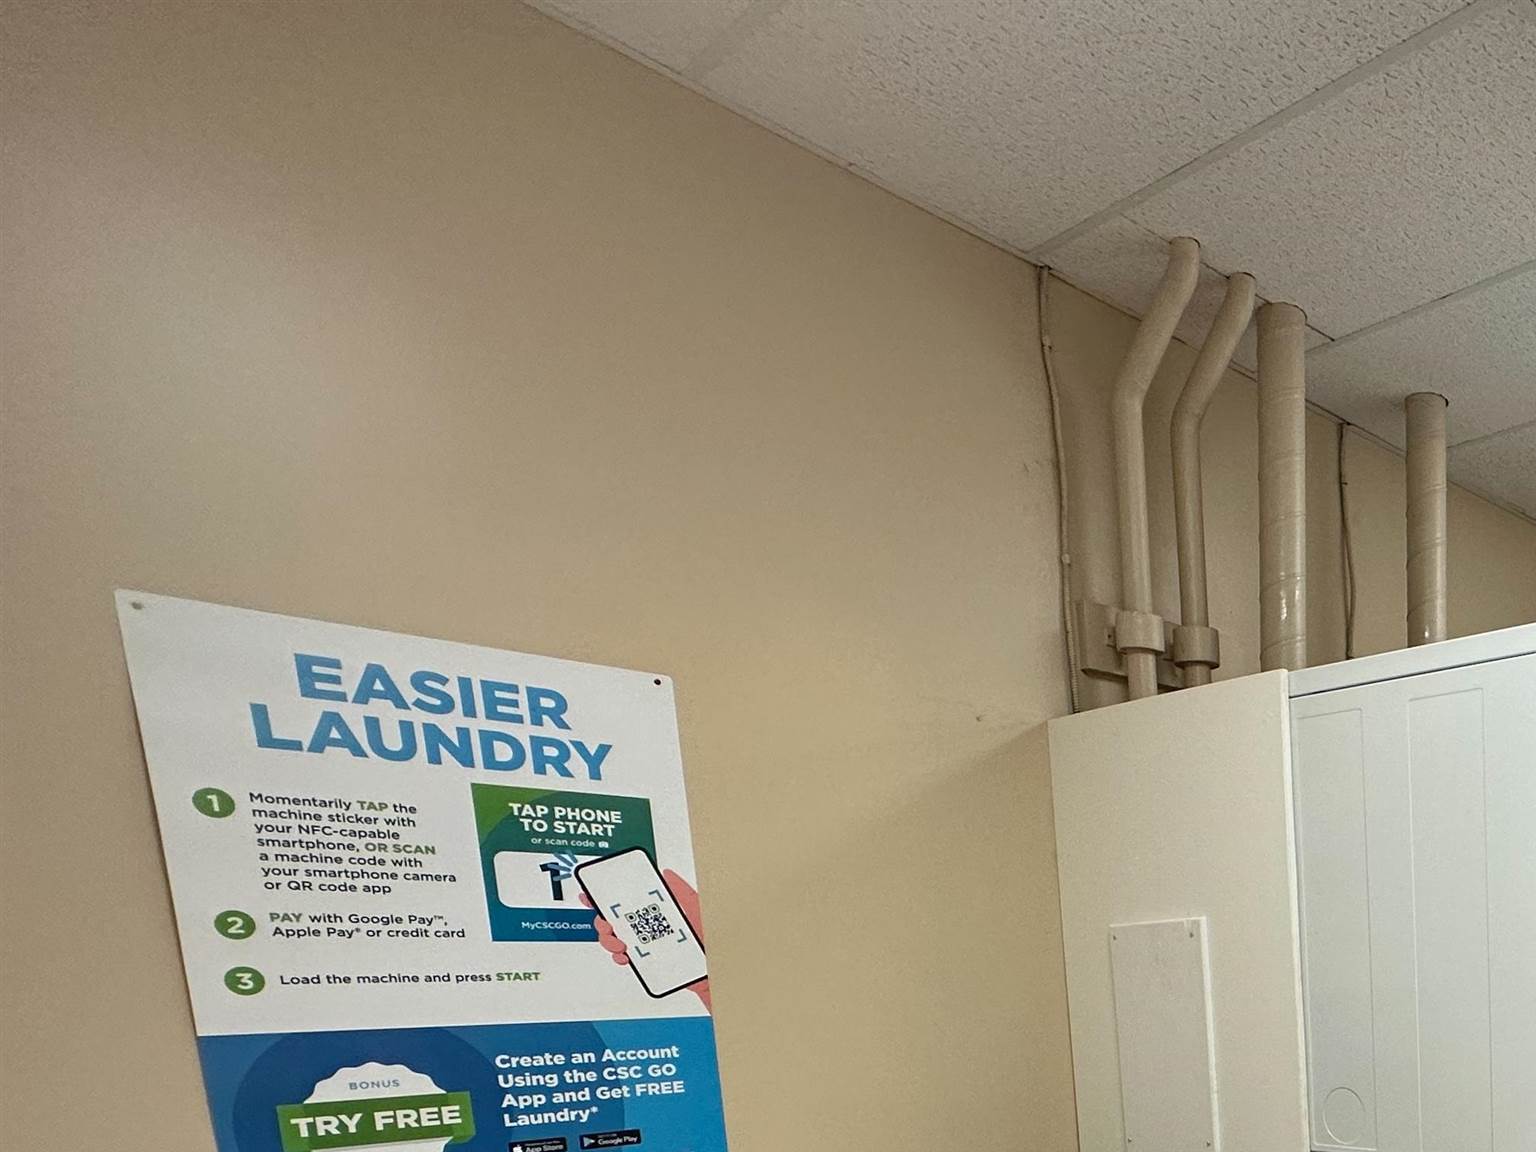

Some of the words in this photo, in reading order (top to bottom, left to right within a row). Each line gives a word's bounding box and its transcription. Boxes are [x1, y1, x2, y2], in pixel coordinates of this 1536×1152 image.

[294, 652, 573, 731] EASIER
[249, 702, 613, 781] LAUNDRY
[207, 794, 220, 812] 1
[249, 792, 351, 811] Momentarily
[357, 800, 388, 811] TAP
[393, 801, 417, 814] the
[252, 808, 322, 822] machine
[327, 812, 379, 825] sticker
[384, 815, 416, 827] with
[508, 802, 549, 818] TAP
[553, 806, 623, 824] PHONE
[254, 823, 292, 834] your
[298, 824, 400, 841] NFC-capable
[519, 818, 548, 832] TO
[553, 821, 616, 837] START
[257, 837, 360, 852] smartphone,
[364, 842, 388, 852] OR
[393, 843, 436, 855] SCAN
[570, 839, 595, 848] code
[259, 852, 269, 861] a
[275, 851, 343, 865] machine
[348, 855, 386, 866] code
[391, 856, 423, 868] with
[261, 865, 299, 878] your
[304, 867, 398, 881] smartphone
[403, 872, 456, 883] camera
[264, 880, 281, 890] or
[287, 880, 313, 892] QR
[318, 881, 357, 893] code
[362, 884, 392, 894] app
[226, 916, 245, 934] 2
[269, 913, 302, 923] PAY
[308, 913, 343, 924] with
[348, 914, 403, 927] Google
[521, 921, 592, 932] MyCSCGO.com
[272, 927, 321, 940] Apple
[366, 930, 382, 938] or
[387, 928, 430, 938] credit
[434, 928, 466, 939] card
[236, 973, 254, 990] 3
[280, 974, 321, 985] Load
[326, 974, 351, 985] the
[356, 973, 420, 984] machine
[424, 973, 450, 983] and
[455, 973, 492, 984] press
[496, 971, 541, 982] START
[495, 1051, 566, 1069] Create
[571, 1051, 596, 1064] an
[601, 1045, 680, 1062] Account
[348, 1079, 401, 1091] BONUS
[498, 1071, 559, 1089] Using
[563, 1069, 598, 1083] the
[602, 1065, 642, 1080] CSC
[647, 1063, 677, 1077] GO
[501, 1092, 547, 1110] App
[552, 1087, 591, 1104] and
[596, 1085, 631, 1100] Get
[635, 1080, 685, 1097] FREE
[289, 1112, 363, 1138] TRY
[373, 1104, 463, 1131] FREE
[543, 1144, 564, 1152] Store
[597, 1137, 622, 1146] Google
[623, 1135, 638, 1143] Play
